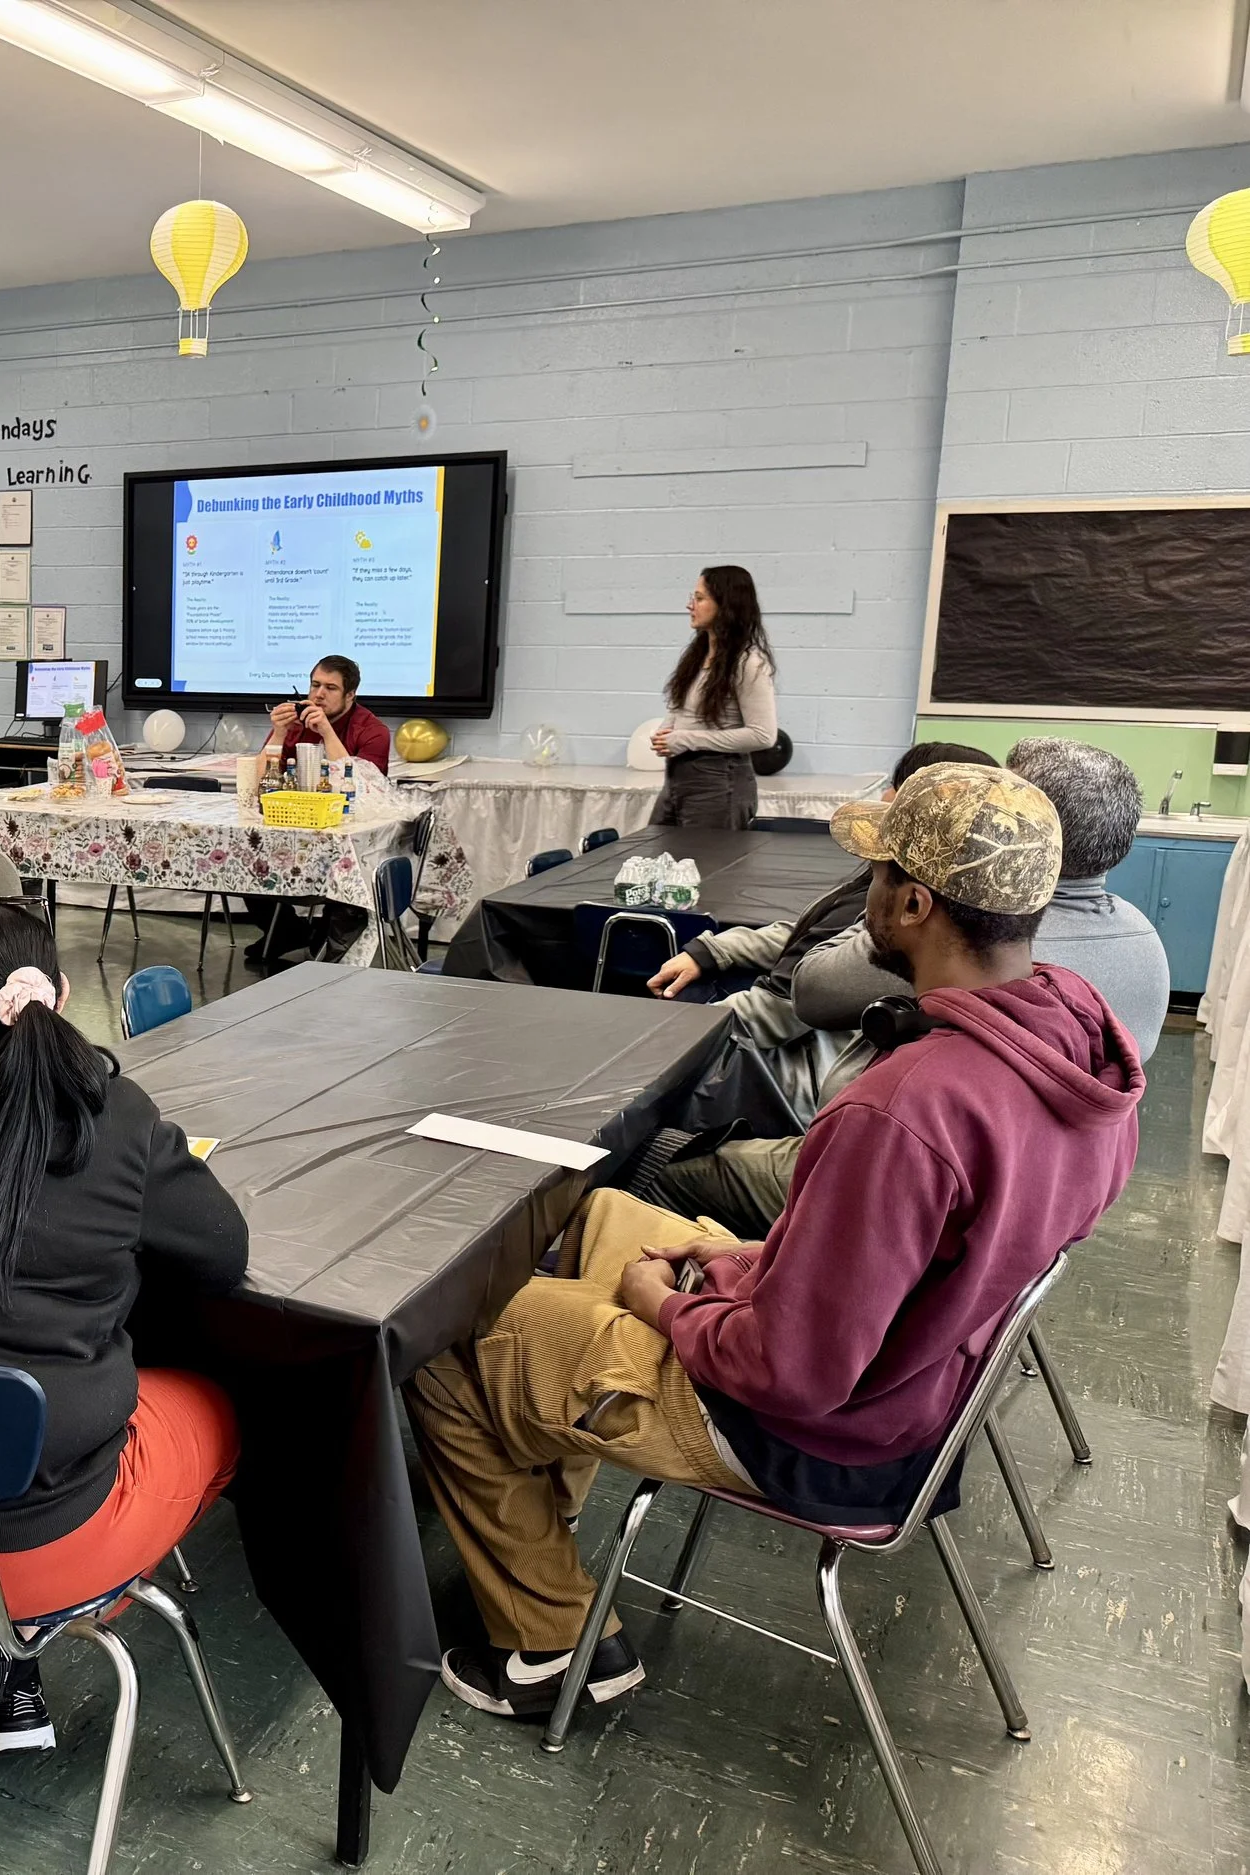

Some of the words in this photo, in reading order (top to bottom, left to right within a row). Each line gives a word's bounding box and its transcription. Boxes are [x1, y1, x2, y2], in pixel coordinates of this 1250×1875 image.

[197, 497, 259, 513] Debunking
[262, 496, 281, 510] the
[284, 494, 314, 509] Early
[317, 490, 381, 508] Childhood
[384, 489, 423, 506] Myths
